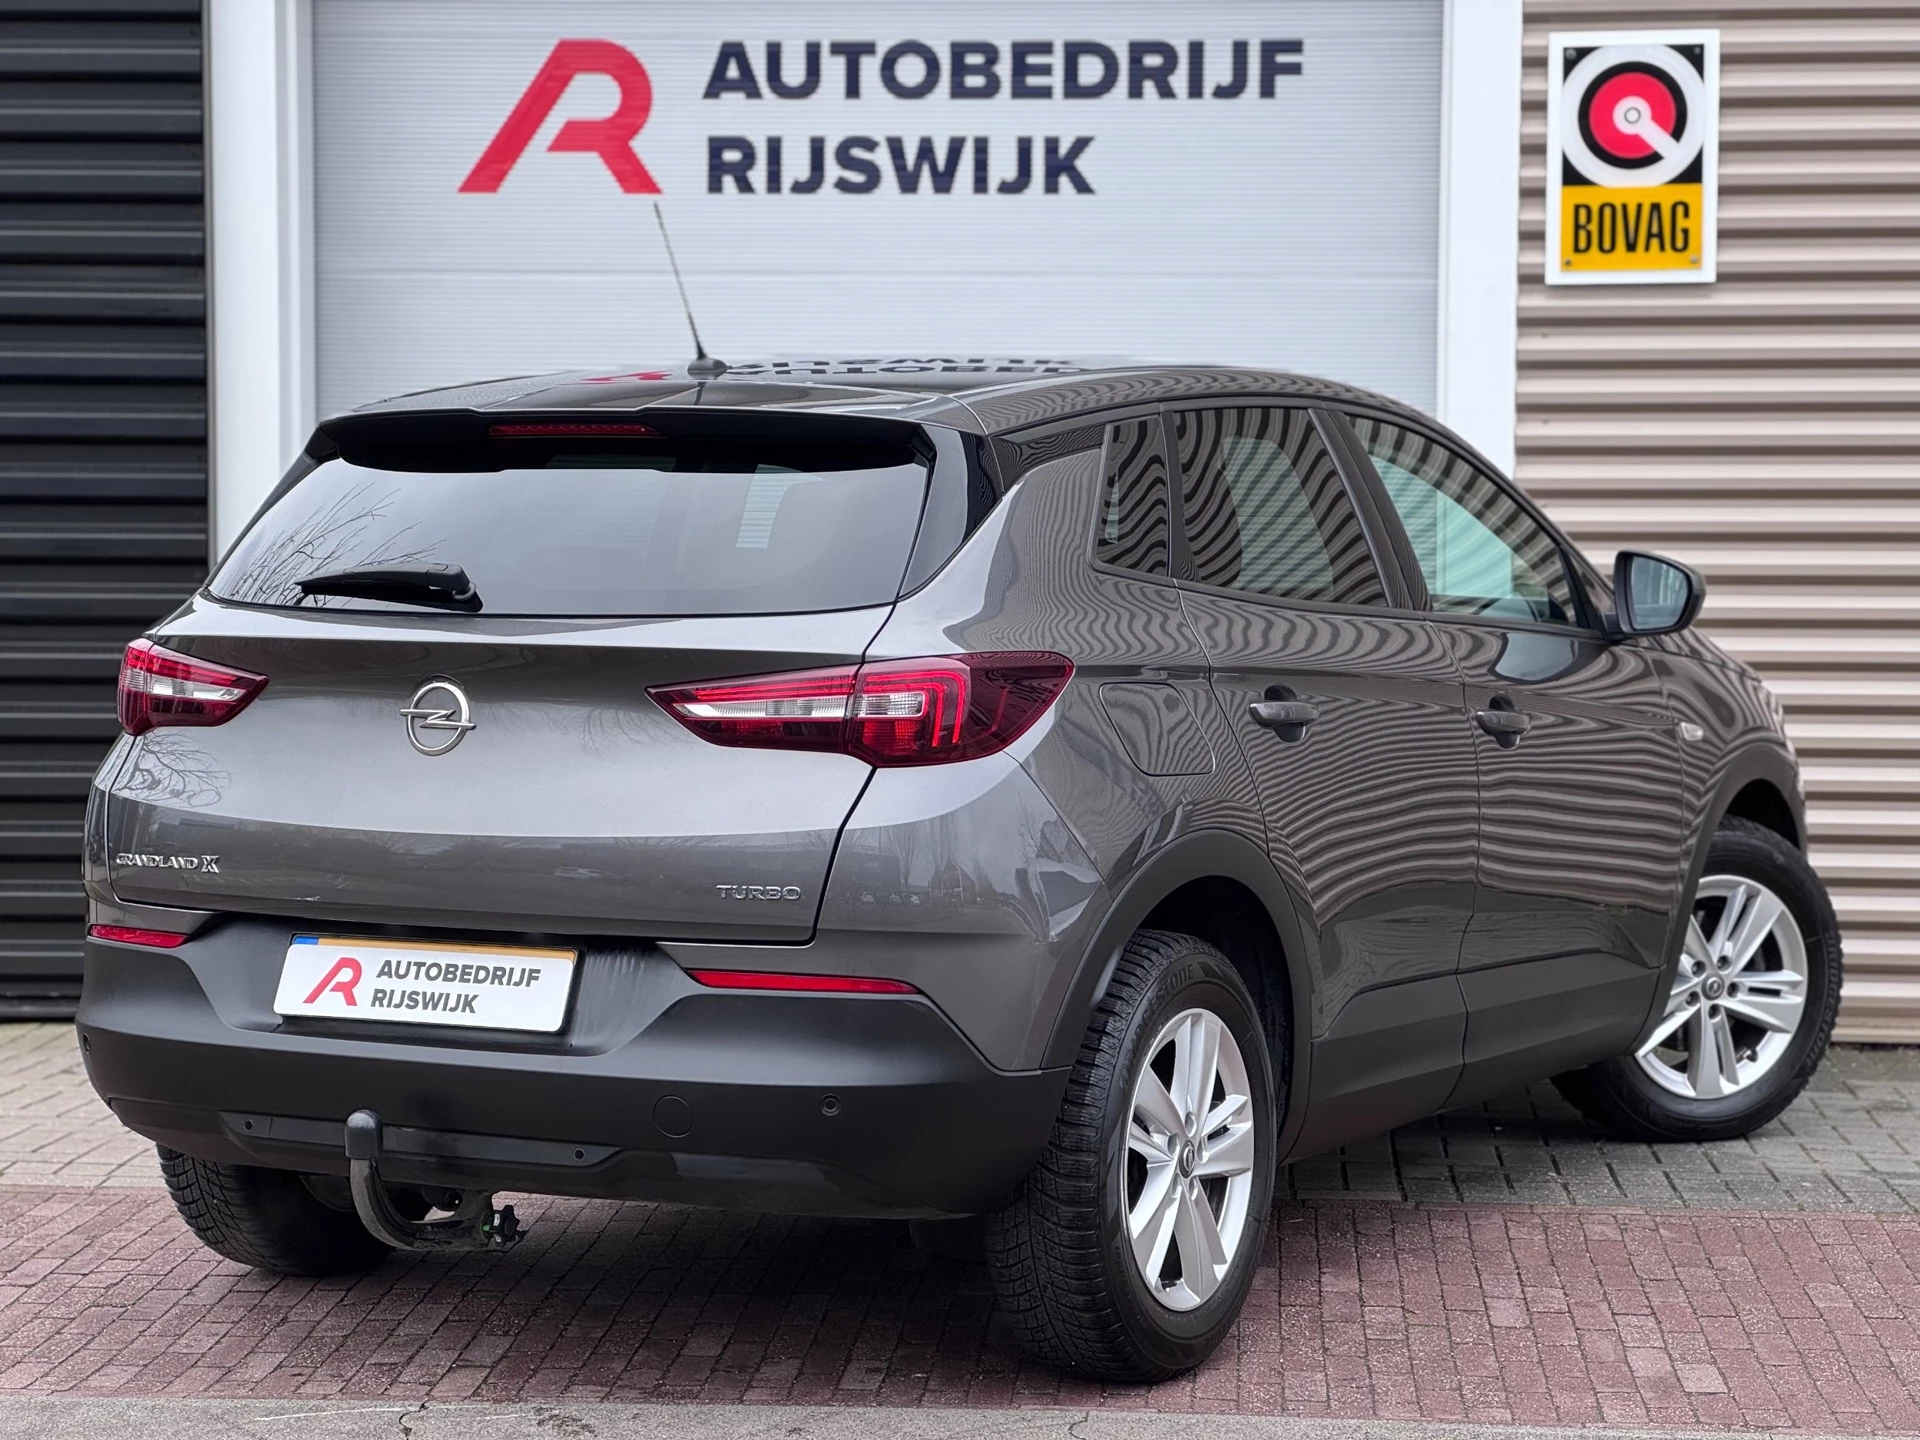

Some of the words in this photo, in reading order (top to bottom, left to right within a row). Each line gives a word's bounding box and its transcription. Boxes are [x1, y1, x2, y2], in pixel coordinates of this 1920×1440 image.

[703, 39, 1304, 100] AUTOBEDRIJF
[707, 136, 1095, 195] RIJSWIJK
[1573, 201, 1690, 254] BOVAG
[115, 852, 199, 869] GRANDLAND
[200, 854, 220, 874] X
[716, 884, 801, 900] TURBO
[376, 959, 541, 988] AUTOBEDRIJF
[370, 988, 479, 1013] RIJSWIJK
